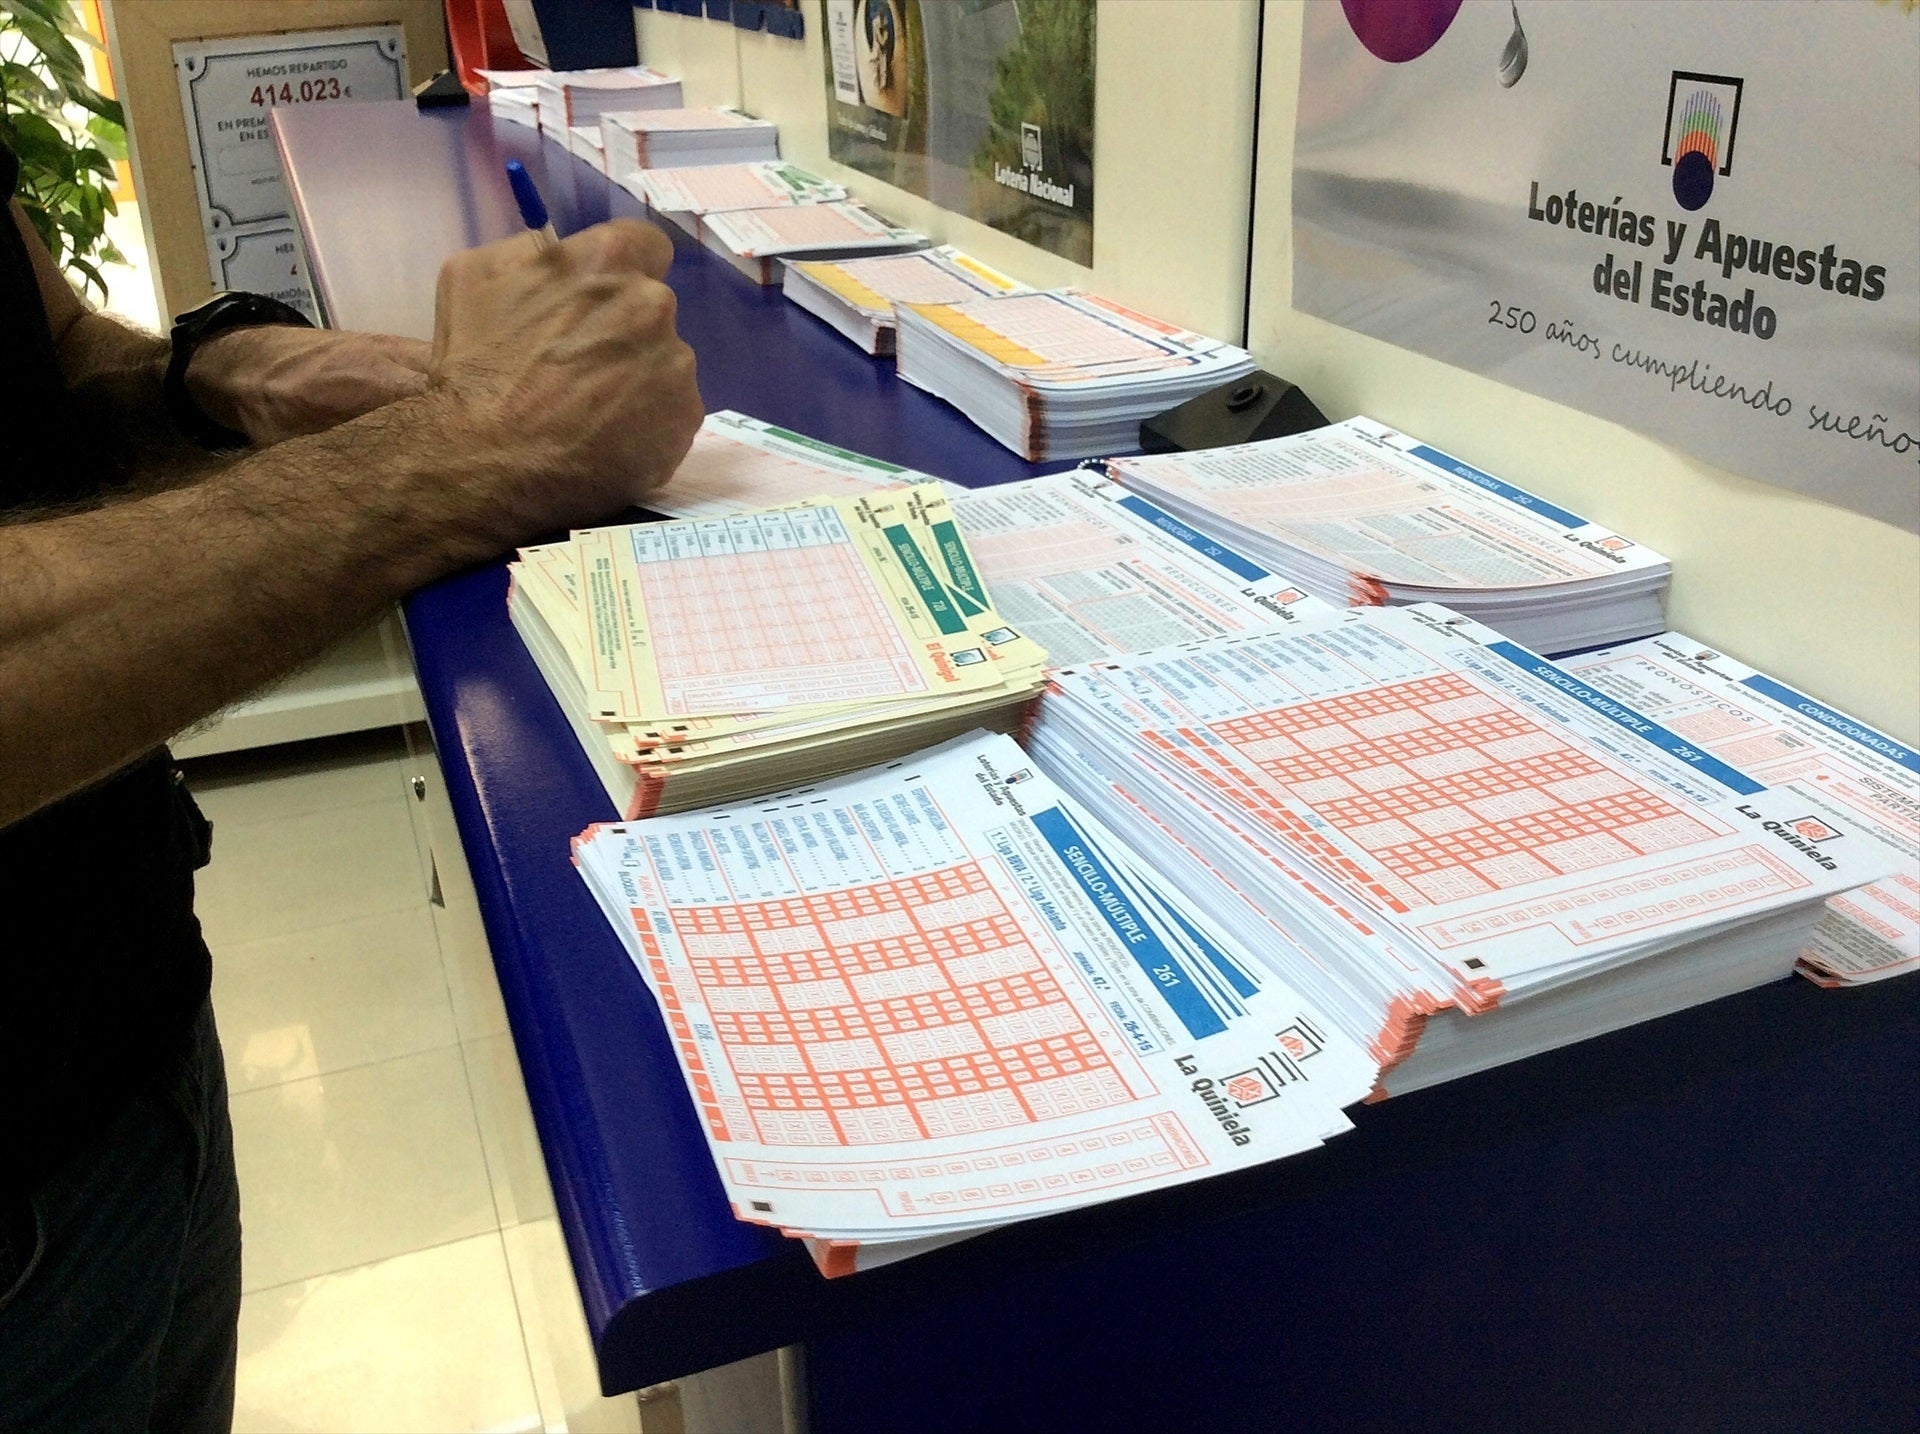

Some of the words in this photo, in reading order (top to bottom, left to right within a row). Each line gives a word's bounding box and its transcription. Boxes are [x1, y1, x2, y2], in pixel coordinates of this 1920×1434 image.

[247, 65, 286, 78] HEMOS
[289, 59, 348, 75] REPARTIDO
[217, 120, 234, 131] EN
[239, 131, 254, 142] EN
[1030, 172, 1075, 208] Nacional
[1528, 181, 1655, 247] Loterías
[1663, 219, 1687, 265] y
[1694, 217, 1887, 302] Apuestas
[1592, 253, 1643, 304] del
[1650, 268, 1778, 341] Estado
[1488, 300, 1537, 335] 250
[1545, 319, 1601, 359] años
[1611, 343, 1793, 417] cumpliendo
[1453, 465, 1501, 492] REDUCIDAS
[1578, 540, 1628, 565] Quiniela
[1240, 588, 1254, 598] La
[1253, 595, 1296, 622] Quiniela
[1532, 666, 1654, 734] SENCILLO-MÚLTIPLE
[1672, 745, 1705, 763] 261
[1635, 660, 1754, 723] PRONÓSTICOS
[1797, 702, 1908, 760] CONDICIONADAS
[976, 754, 999, 786] Loterías
[983, 781, 1004, 807] Estado
[1735, 803, 1762, 820] La
[1761, 819, 1839, 872] Quiniela
[998, 839, 1013, 858] Liga
[1028, 885, 1046, 906] Liga
[1039, 901, 1067, 932] Adelante
[1063, 844, 1149, 945] SENCILLO-MÚLTIPLE
[1152, 963, 1181, 989] 261
[1174, 1053, 1199, 1077] La
[1191, 1077, 1252, 1148] Quiniela
